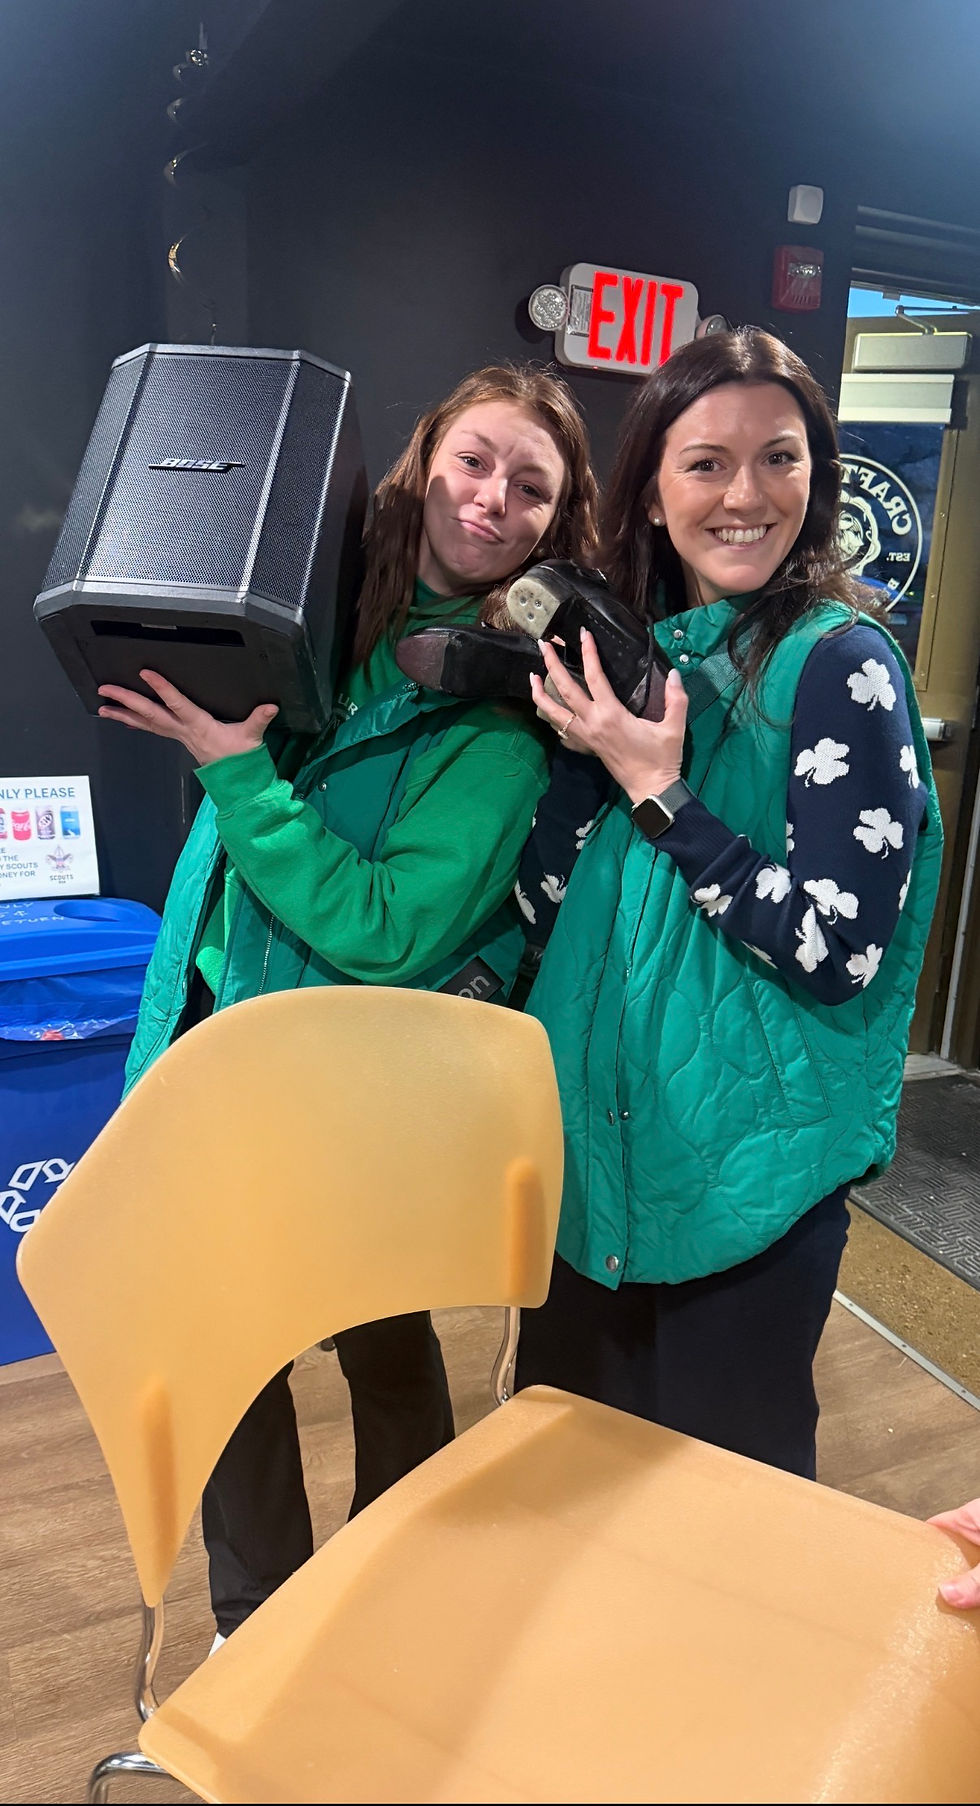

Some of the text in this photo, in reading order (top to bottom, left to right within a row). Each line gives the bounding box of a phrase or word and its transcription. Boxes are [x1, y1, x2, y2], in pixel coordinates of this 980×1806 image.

[587, 271, 684, 367] EXIT
[157, 458, 235, 472] BOSE
[25, 787, 76, 799] PLEASE
[6, 862, 39, 870] SCOUTS
